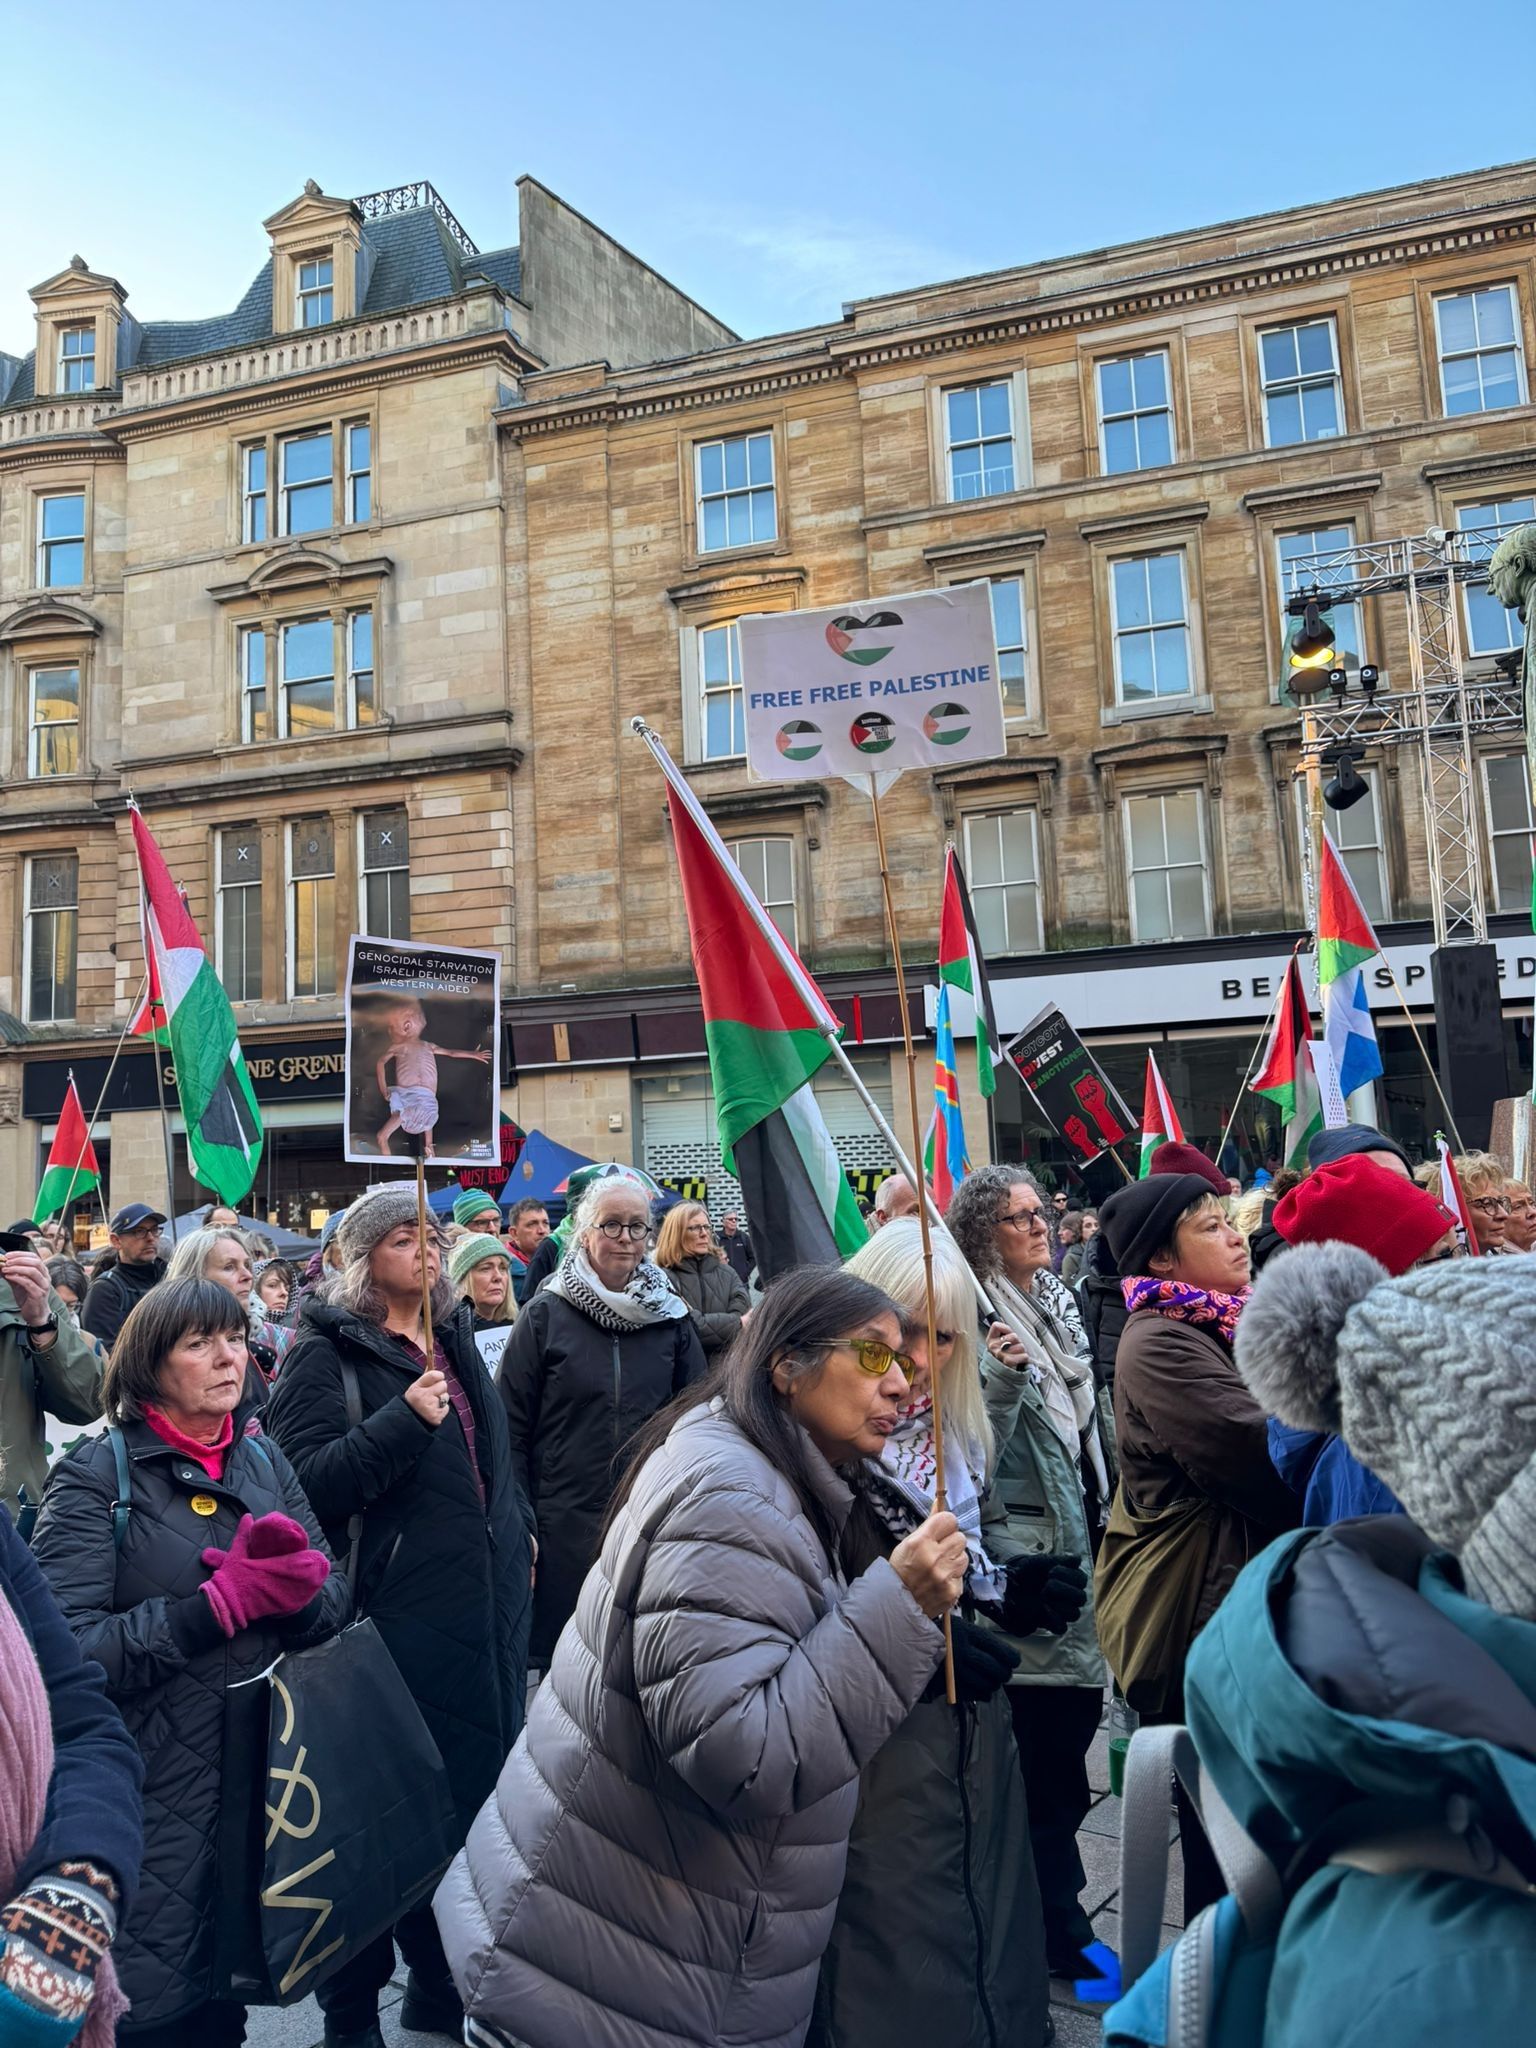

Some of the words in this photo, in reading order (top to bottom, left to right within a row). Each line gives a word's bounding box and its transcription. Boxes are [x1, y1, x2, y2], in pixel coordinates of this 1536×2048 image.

[750, 690, 803, 709] FREE
[810, 682, 862, 704] FREE
[869, 665, 991, 696] PALESTINE
[358, 951, 423, 967] GENOCIDAL
[426, 959, 493, 975] STARVATION
[372, 965, 415, 977] ISRAELI
[418, 970, 479, 984] DELIVERED
[380, 977, 434, 990] WESTERN
[437, 984, 470, 994] AIDED
[1014, 1017, 1066, 1064] BOYCOTT
[1021, 1040, 1064, 1078] DIVEST
[1030, 1046, 1085, 1090] SANCTIONS
[487, 1166, 509, 1184] END
